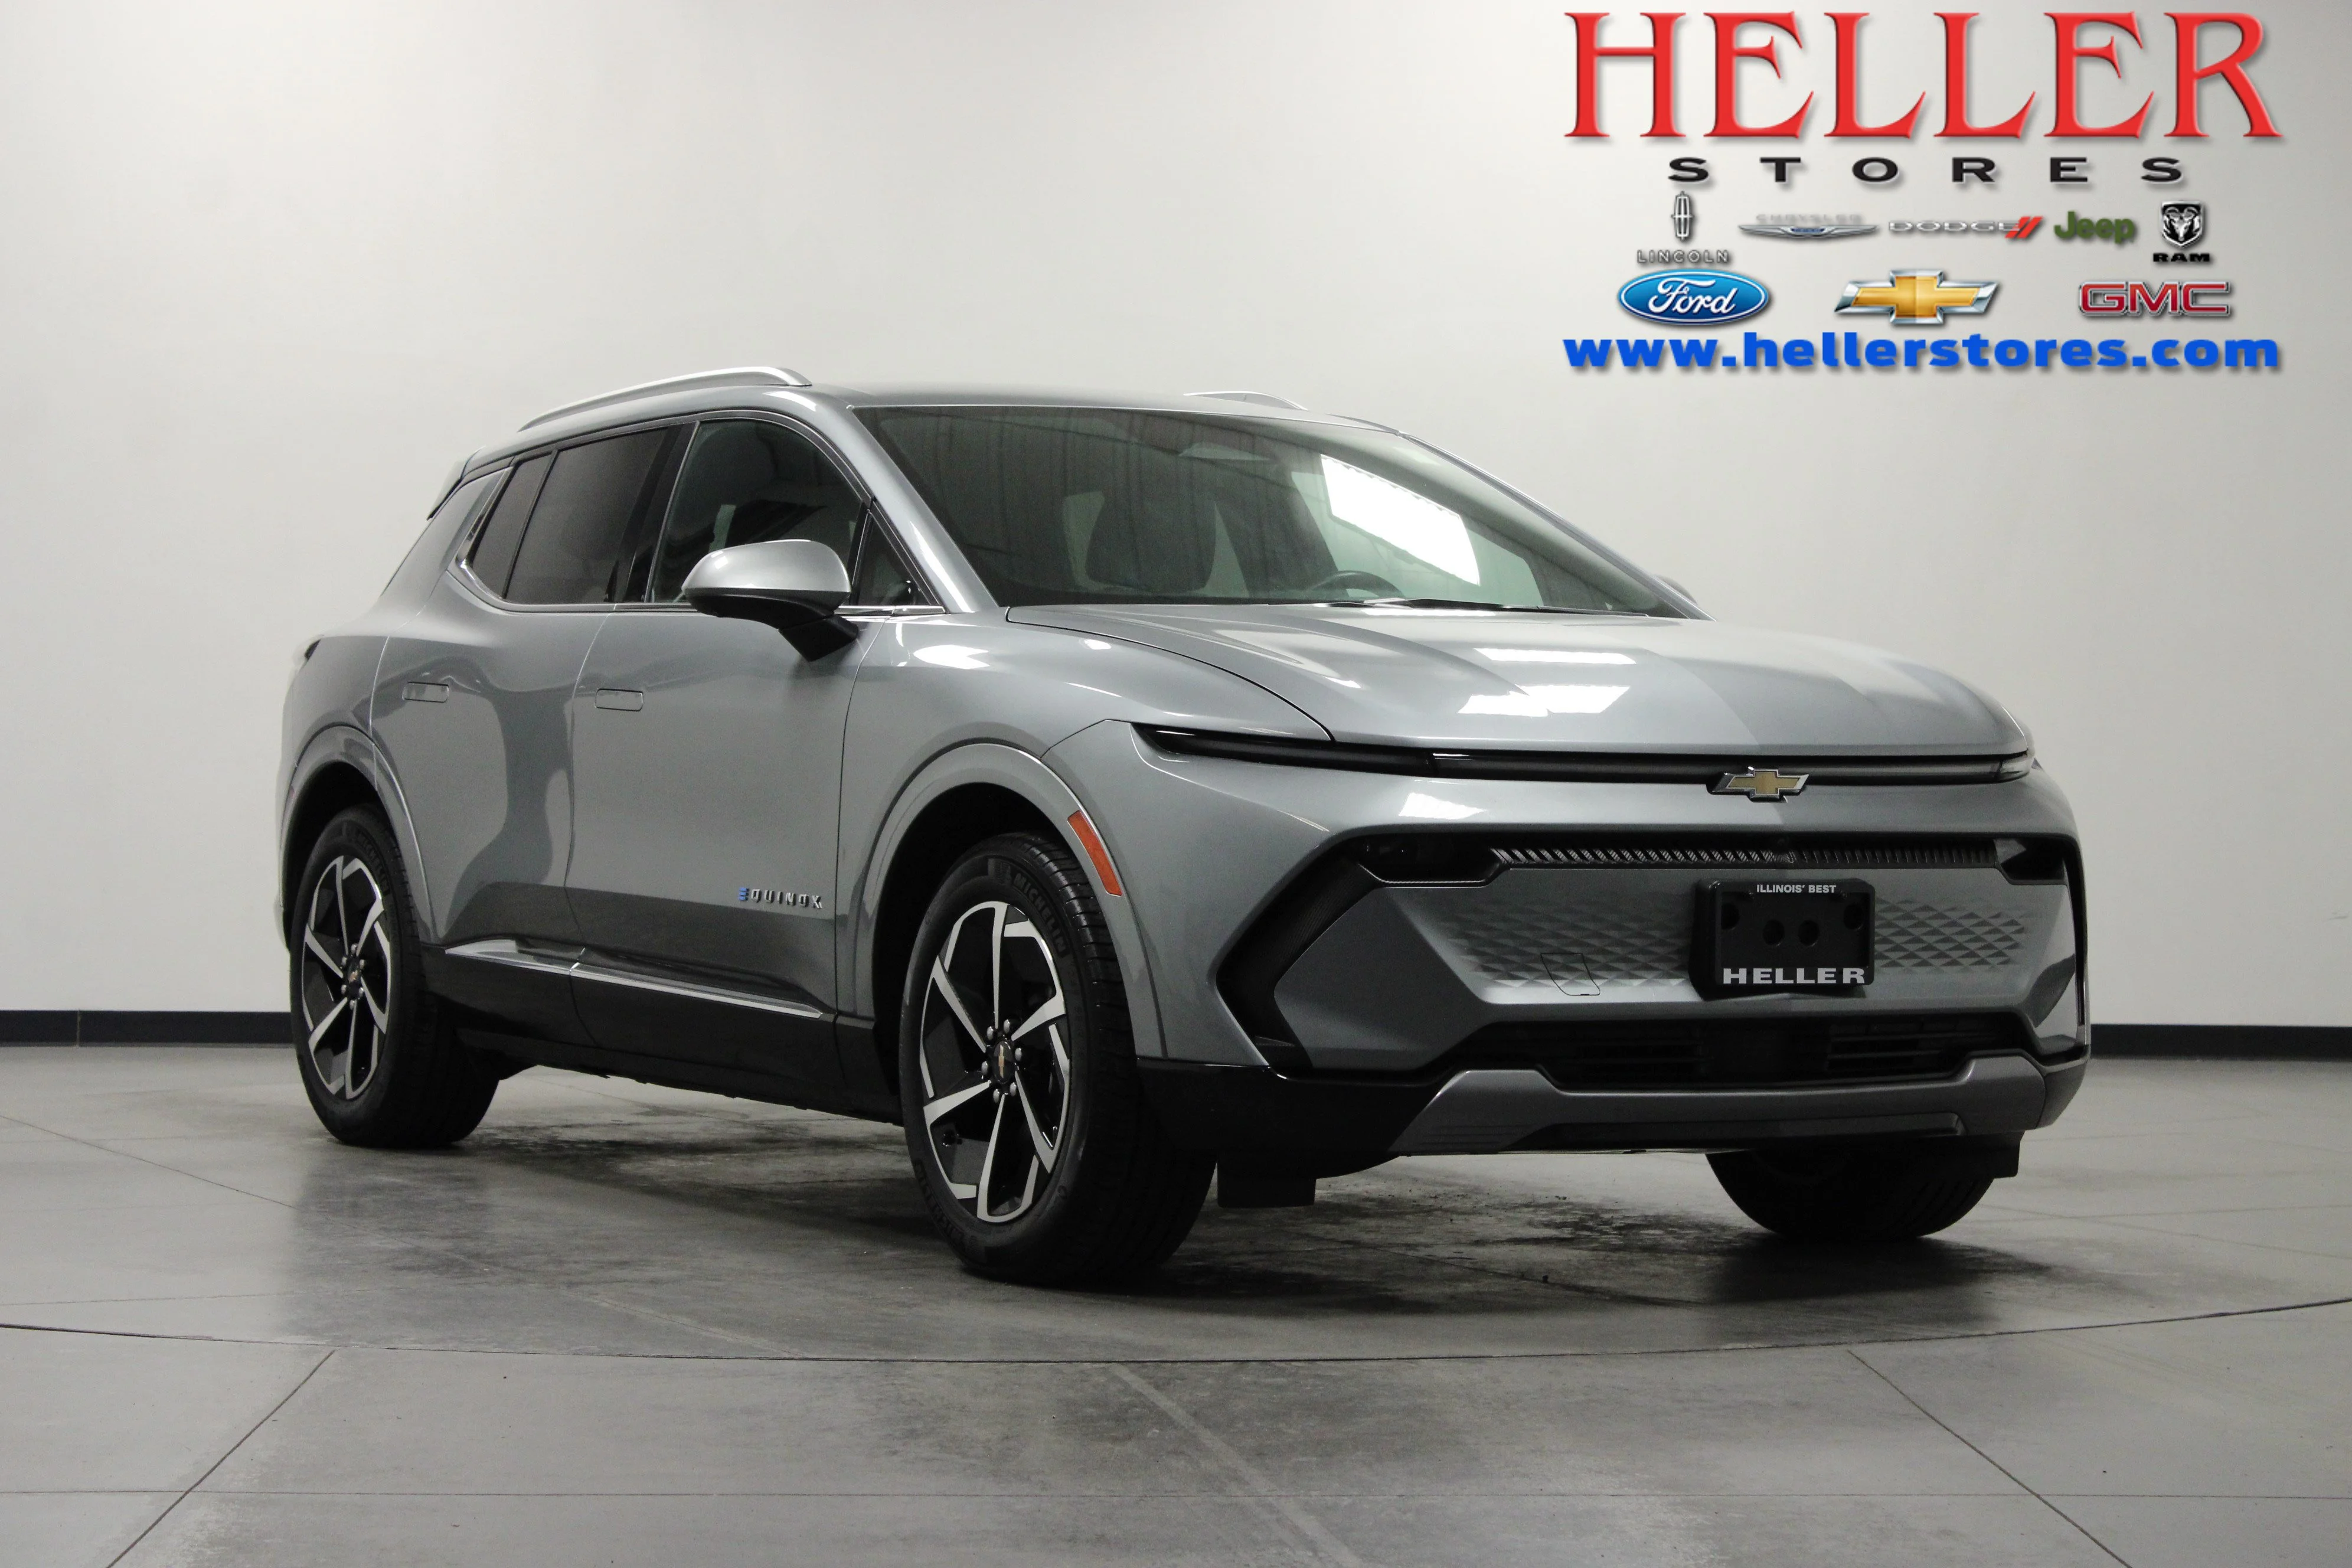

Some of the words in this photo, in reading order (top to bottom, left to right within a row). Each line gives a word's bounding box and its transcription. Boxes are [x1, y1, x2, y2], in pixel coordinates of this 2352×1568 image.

[739, 887, 823, 909] EQUINOX
[1756, 884, 1805, 893] ILLINOIS'
[1808, 884, 1837, 893] BEST
[1013, 873, 1066, 953] MICHELIN
[1723, 968, 1866, 984] HELLER
